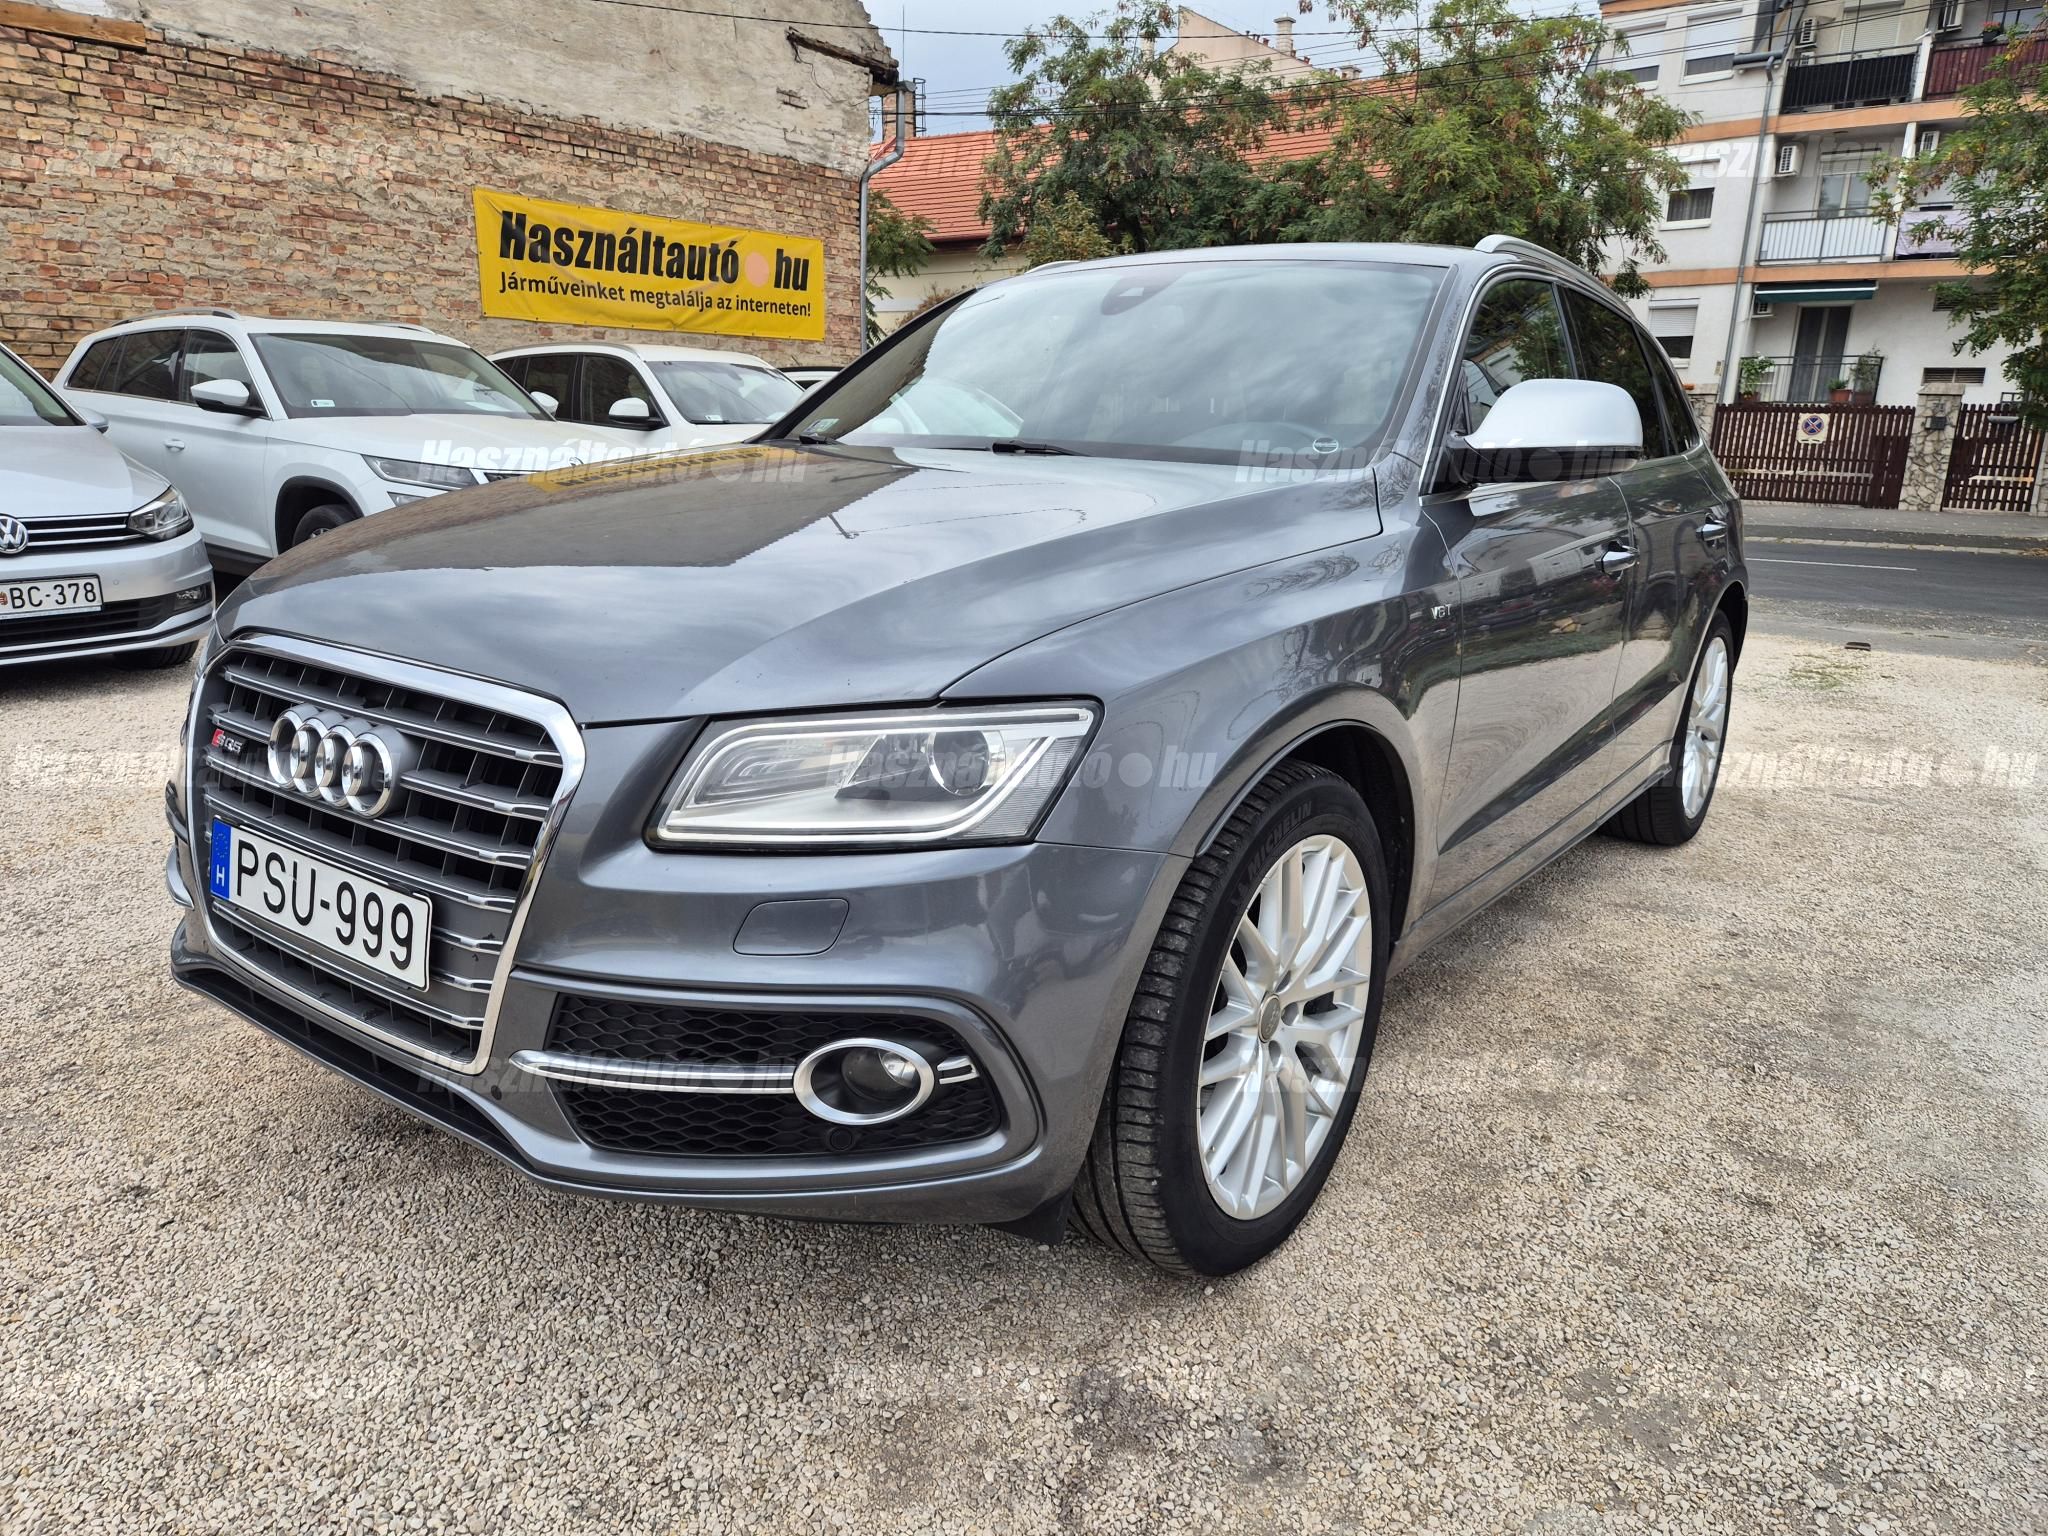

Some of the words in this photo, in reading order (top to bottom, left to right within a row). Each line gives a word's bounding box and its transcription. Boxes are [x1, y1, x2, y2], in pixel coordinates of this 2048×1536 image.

[499, 210, 739, 285] Használtautó
[499, 271, 626, 302] Járműveinket
[630, 288, 713, 313] megtalálja
[716, 296, 733, 312] az
[735, 294, 812, 318] interneten!
[9, 581, 97, 610] BC-378
[216, 864, 225, 888] H
[236, 838, 414, 971] PSU-999
